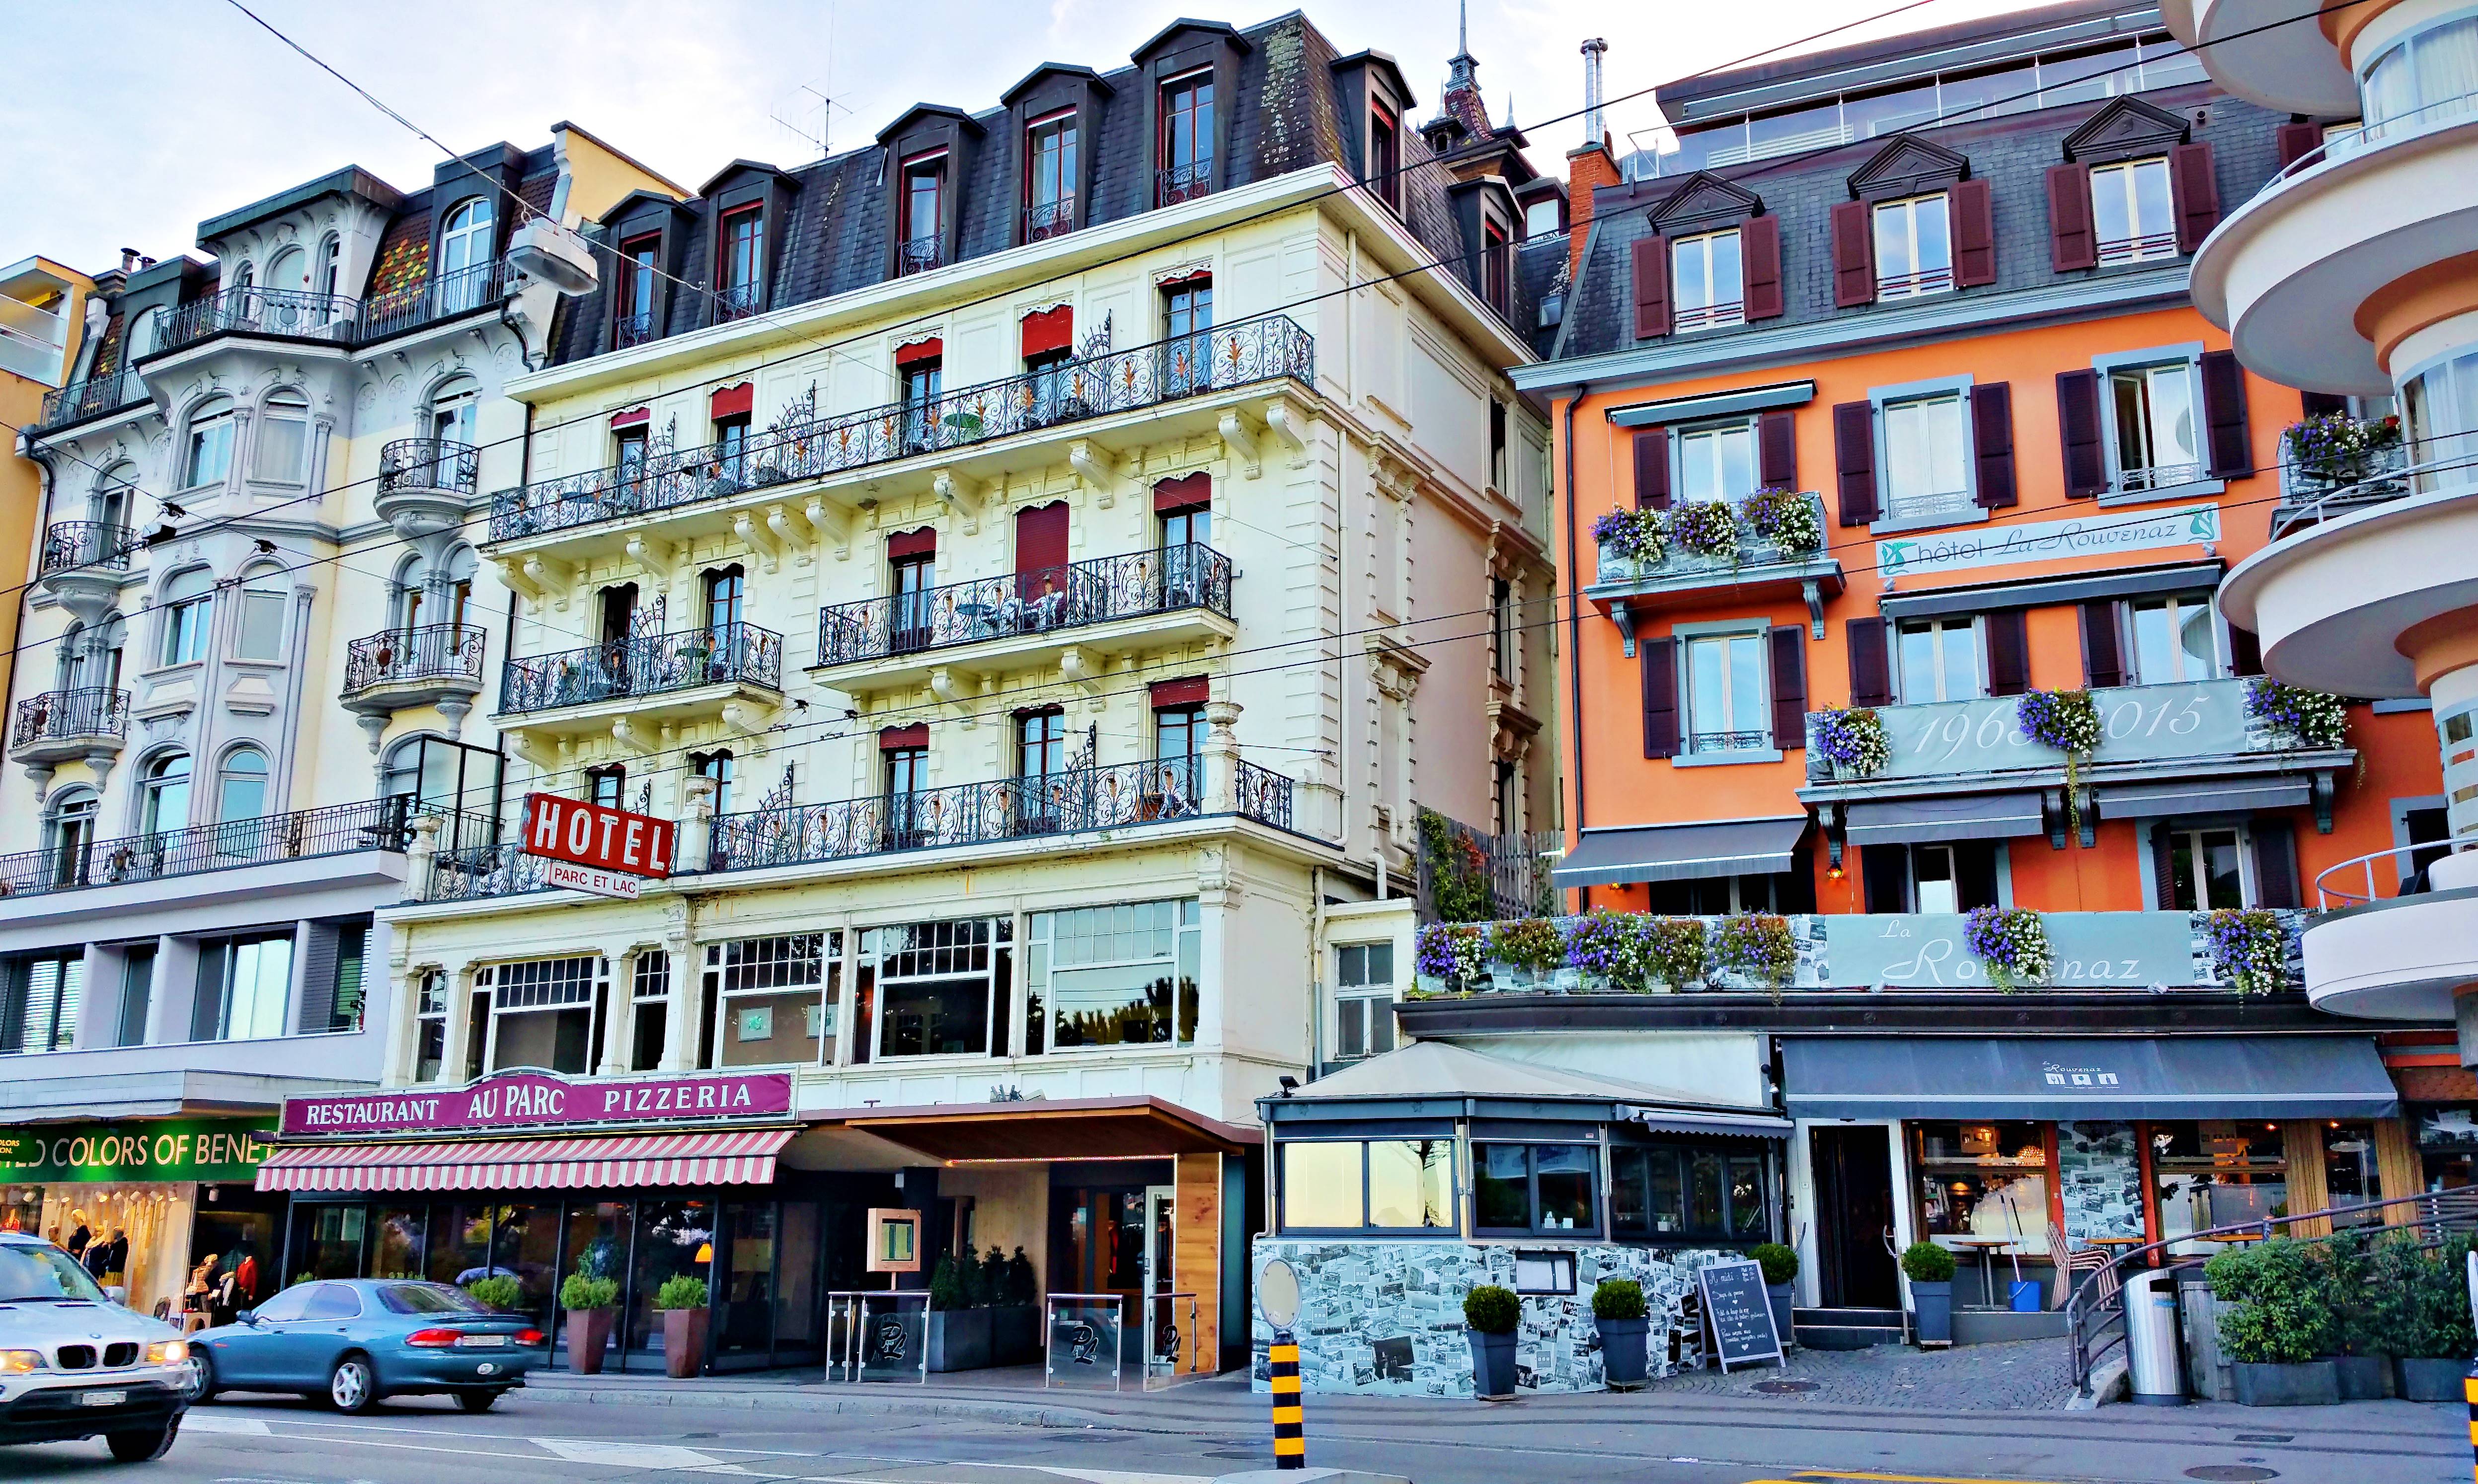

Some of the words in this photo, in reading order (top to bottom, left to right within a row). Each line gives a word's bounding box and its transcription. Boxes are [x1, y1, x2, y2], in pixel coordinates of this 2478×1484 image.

[1918, 539, 1982, 564] hôtel
[1993, 528, 2032, 556] La
[2037, 522, 2177, 550] Rouvenaz
[2092, 695, 2211, 740] 015
[534, 800, 665, 871] HOTEL
[554, 868, 588, 885] PARC
[593, 875, 609, 888] ET
[613, 879, 636, 894] LAC
[1878, 919, 1912, 938] La
[306, 1100, 440, 1125] RESTAURANT
[467, 1087, 498, 1119] AU
[504, 1084, 565, 1117] PARC
[603, 1084, 752, 1113] PIZZERIA
[52, 1135, 149, 1166] COLORS
[155, 1134, 190, 1165] OF
